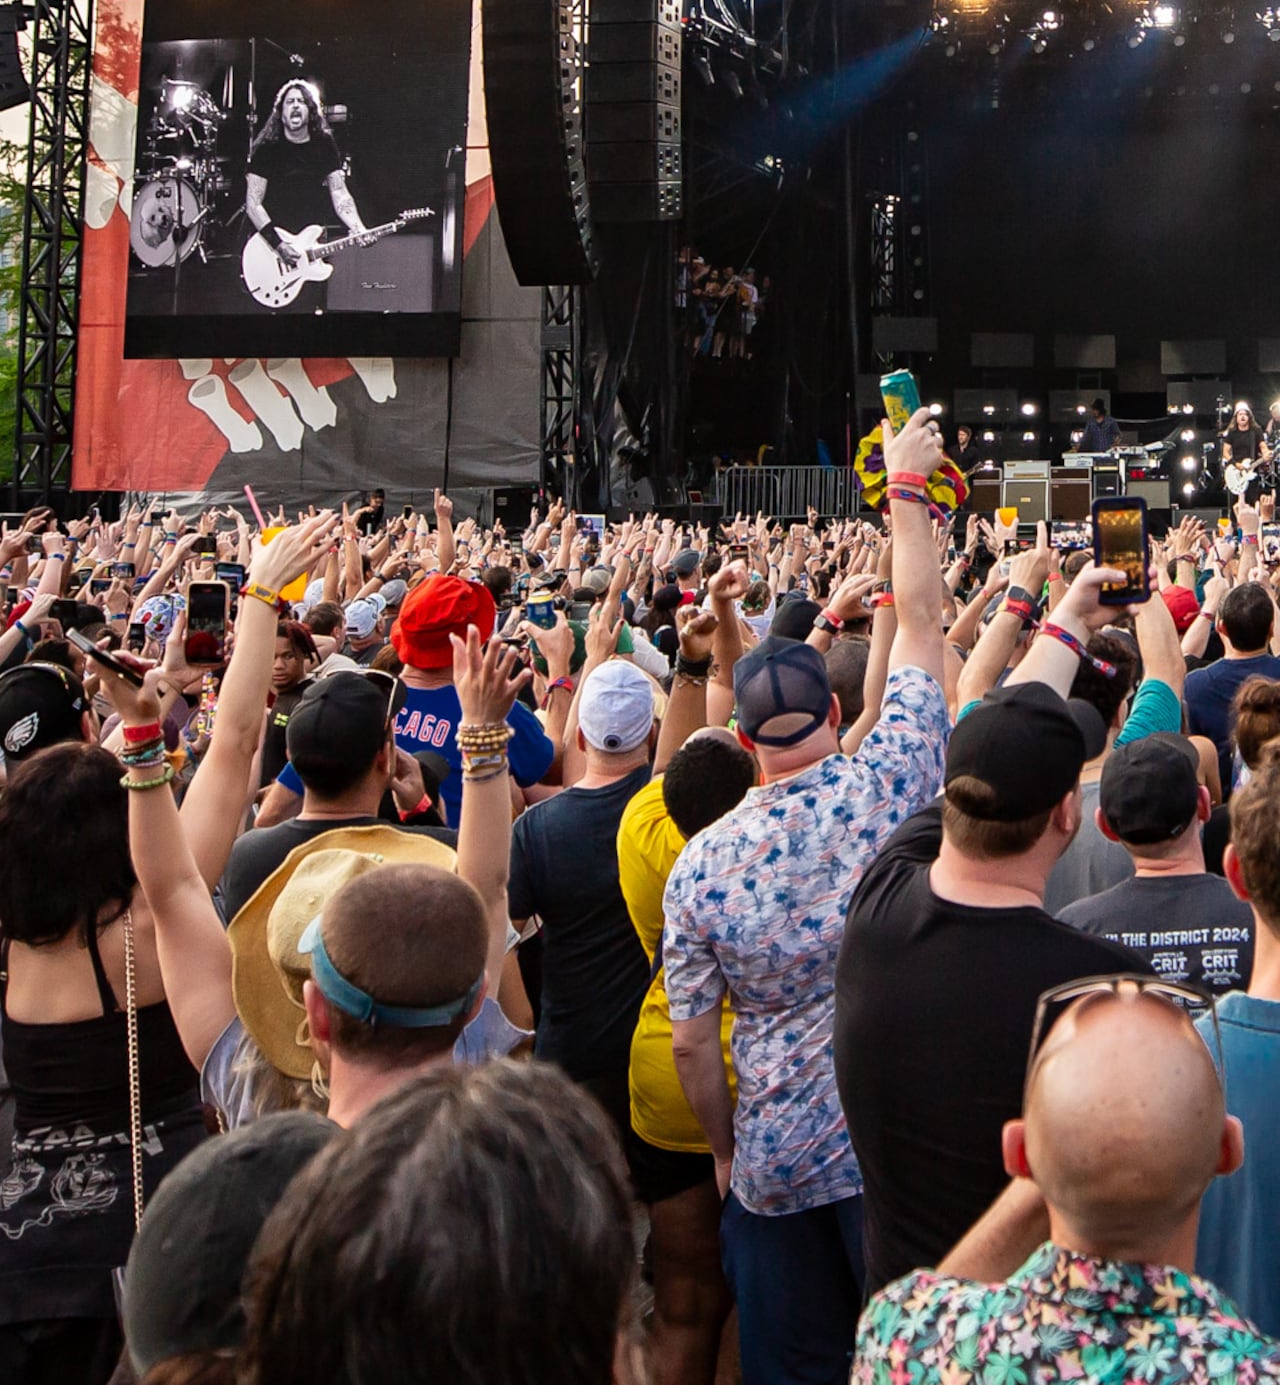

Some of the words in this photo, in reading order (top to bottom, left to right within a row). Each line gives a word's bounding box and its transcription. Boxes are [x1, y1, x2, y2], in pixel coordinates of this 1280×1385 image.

[393, 707, 451, 748] CAGO
[1121, 932, 1147, 947] THE
[1150, 928, 1210, 947] DISTRICT
[1212, 927, 1250, 943] 2024
[1151, 956, 1188, 972] CRIT
[1201, 954, 1240, 969] CRIT
